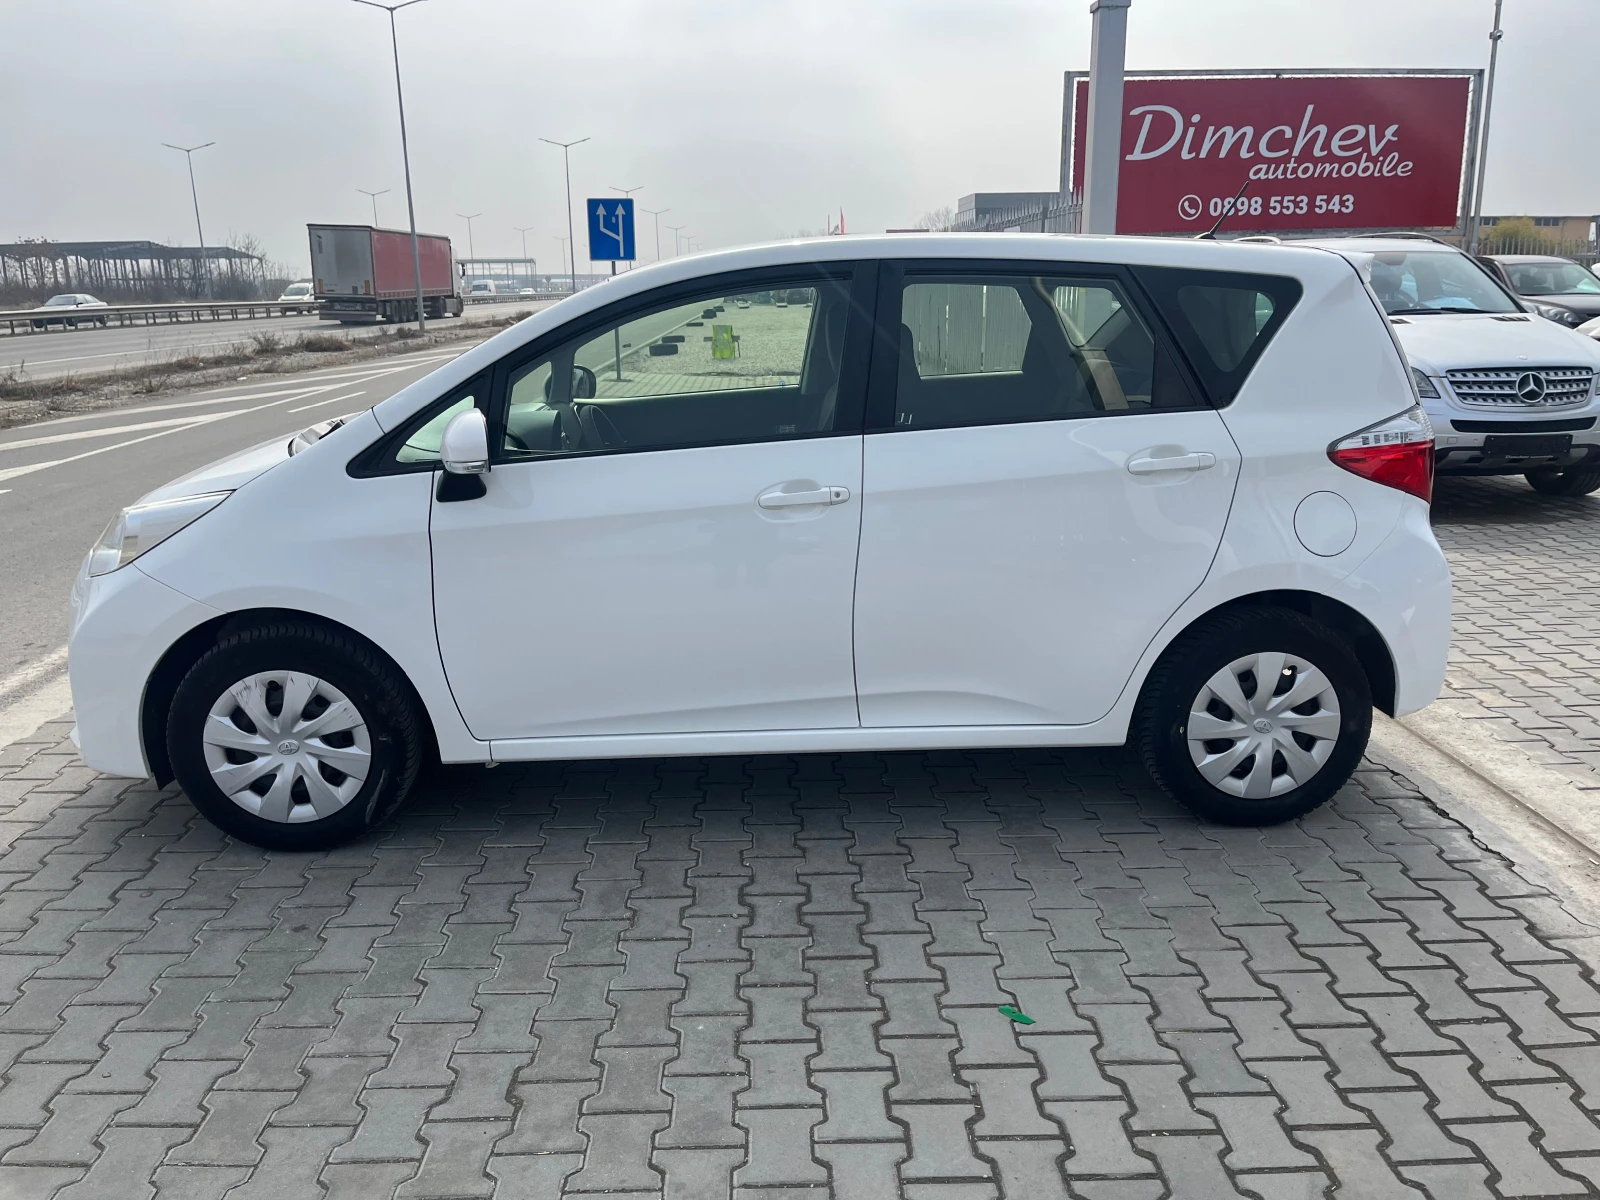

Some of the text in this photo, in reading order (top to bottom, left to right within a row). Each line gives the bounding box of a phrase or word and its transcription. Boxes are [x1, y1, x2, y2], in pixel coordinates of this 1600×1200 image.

[1125, 104, 1399, 160] Dimchev
[1249, 152, 1413, 180] automobile
[1209, 194, 1354, 217] 0898 553 543
